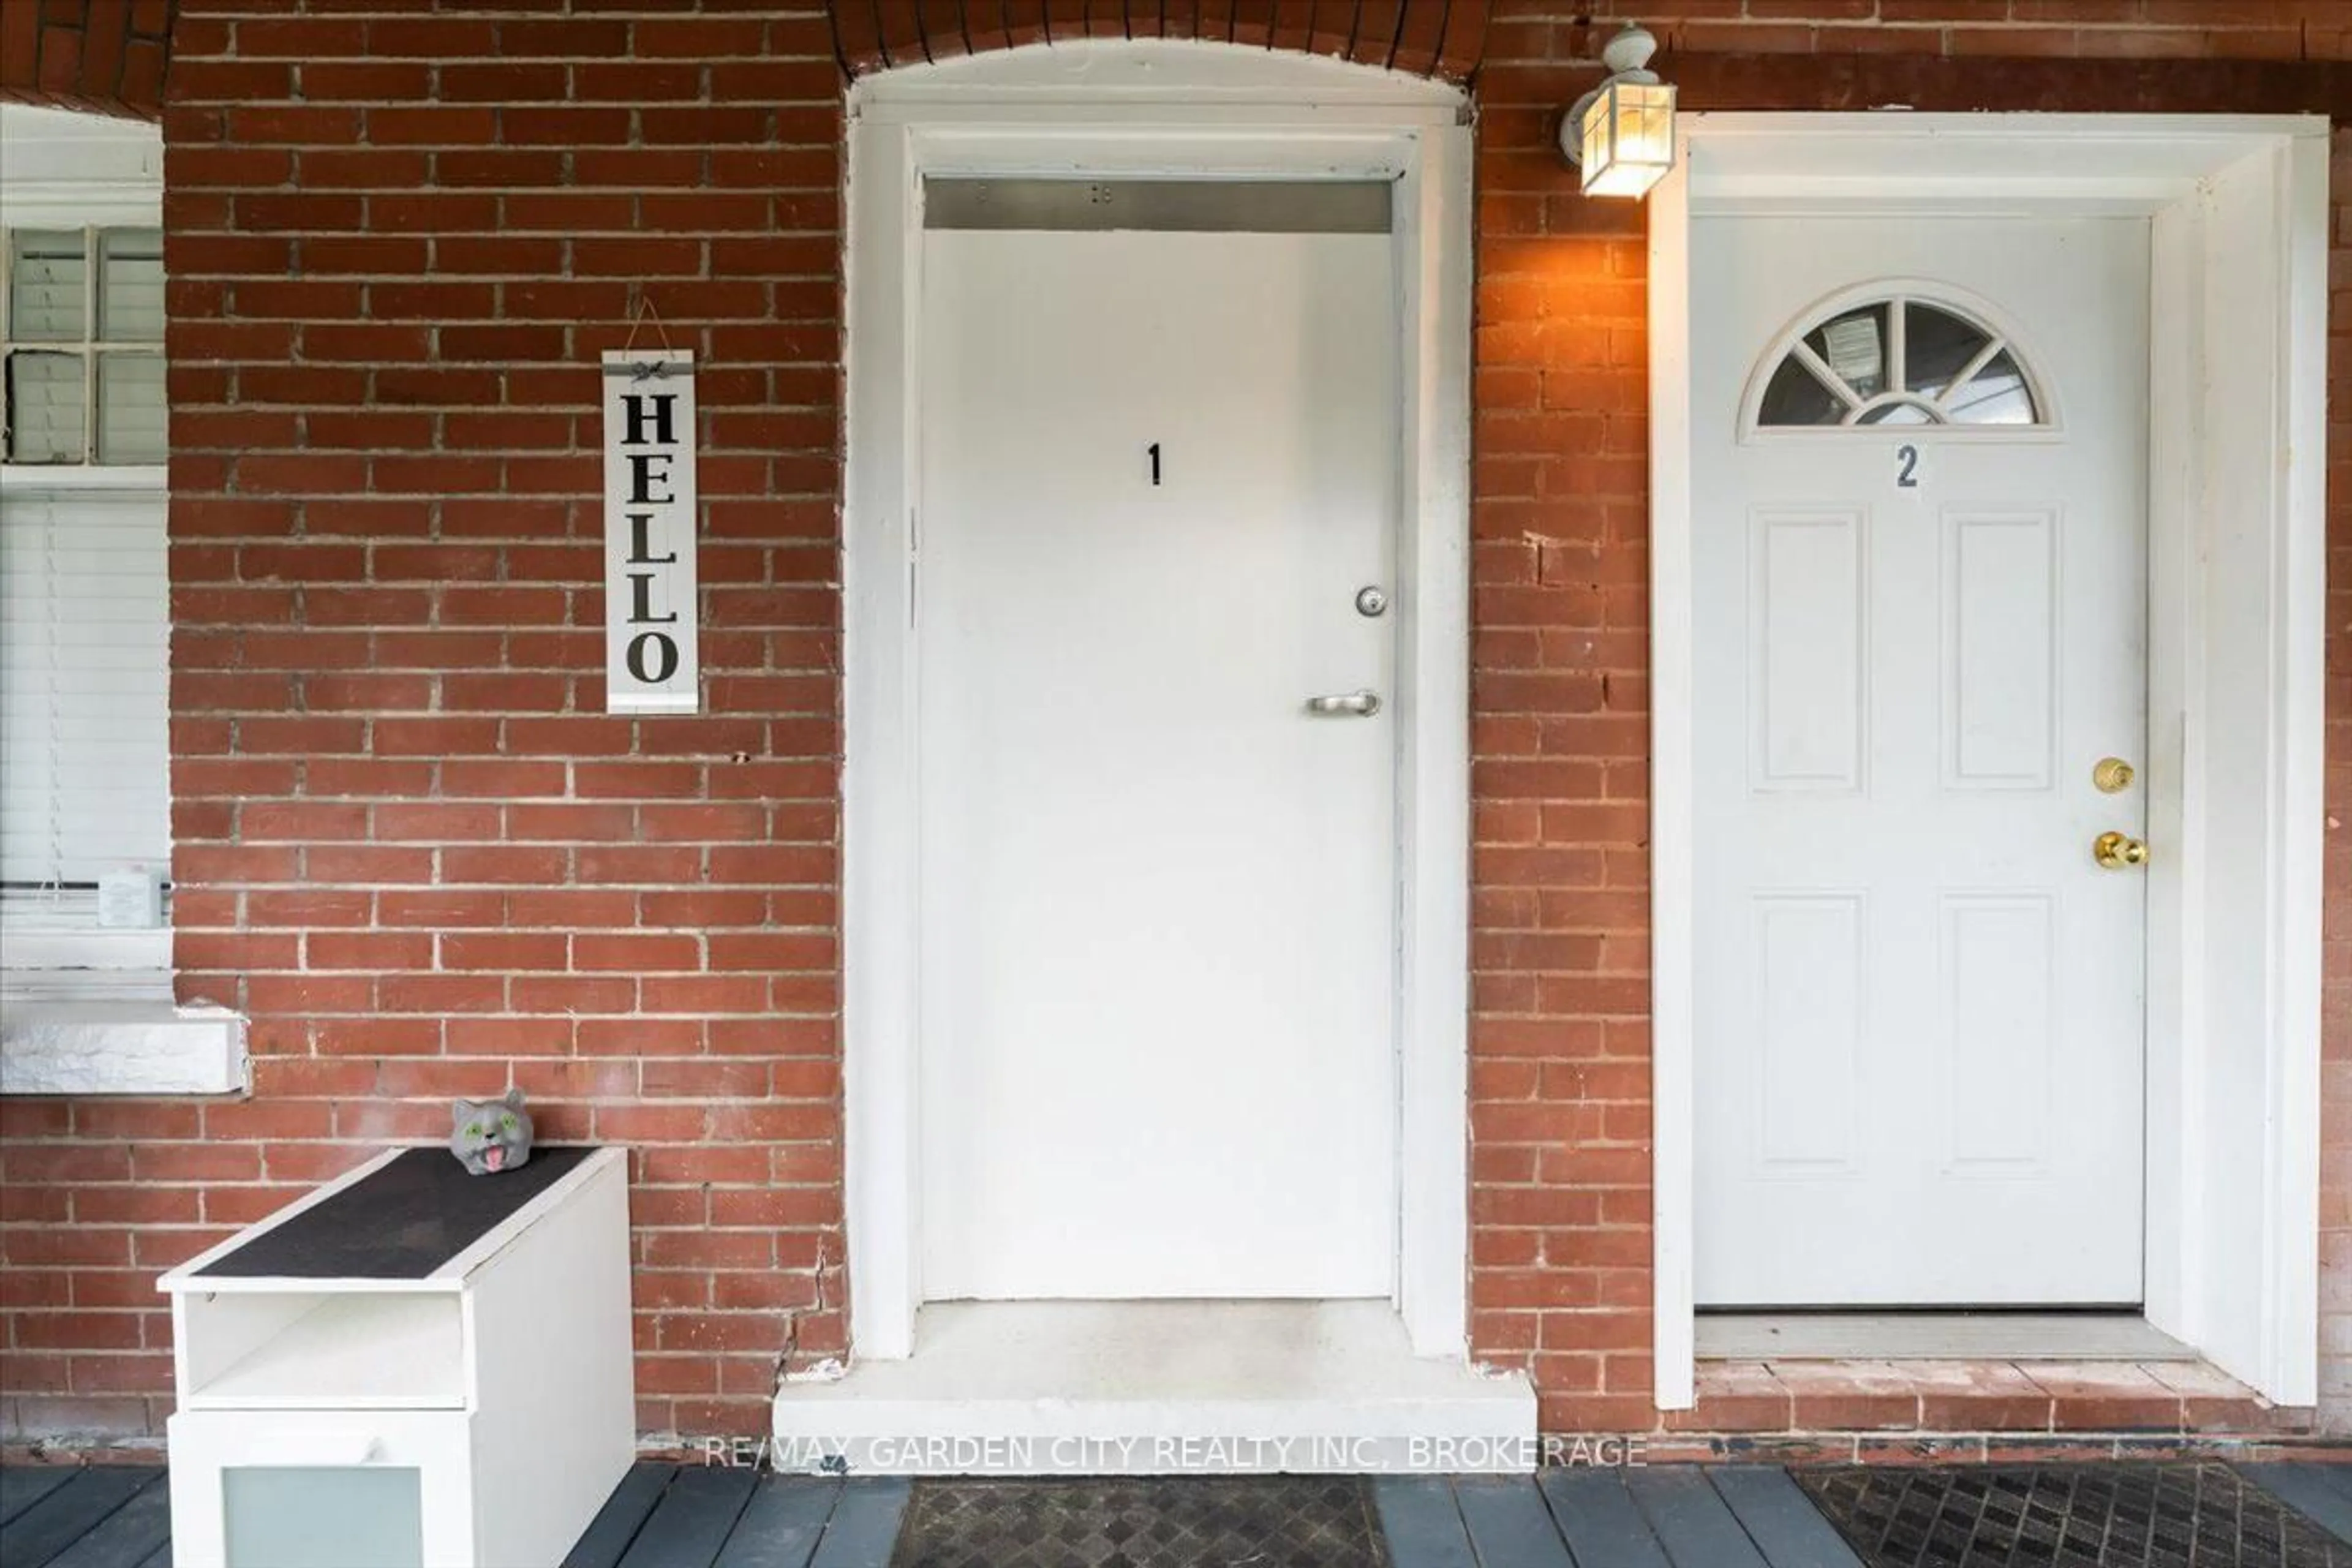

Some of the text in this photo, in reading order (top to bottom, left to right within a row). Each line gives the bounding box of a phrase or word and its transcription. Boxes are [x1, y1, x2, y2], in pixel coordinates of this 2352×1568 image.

[1148, 442, 1159, 486] 1
[1898, 445, 1917, 487] 2
[620, 394, 679, 683] HELLO
